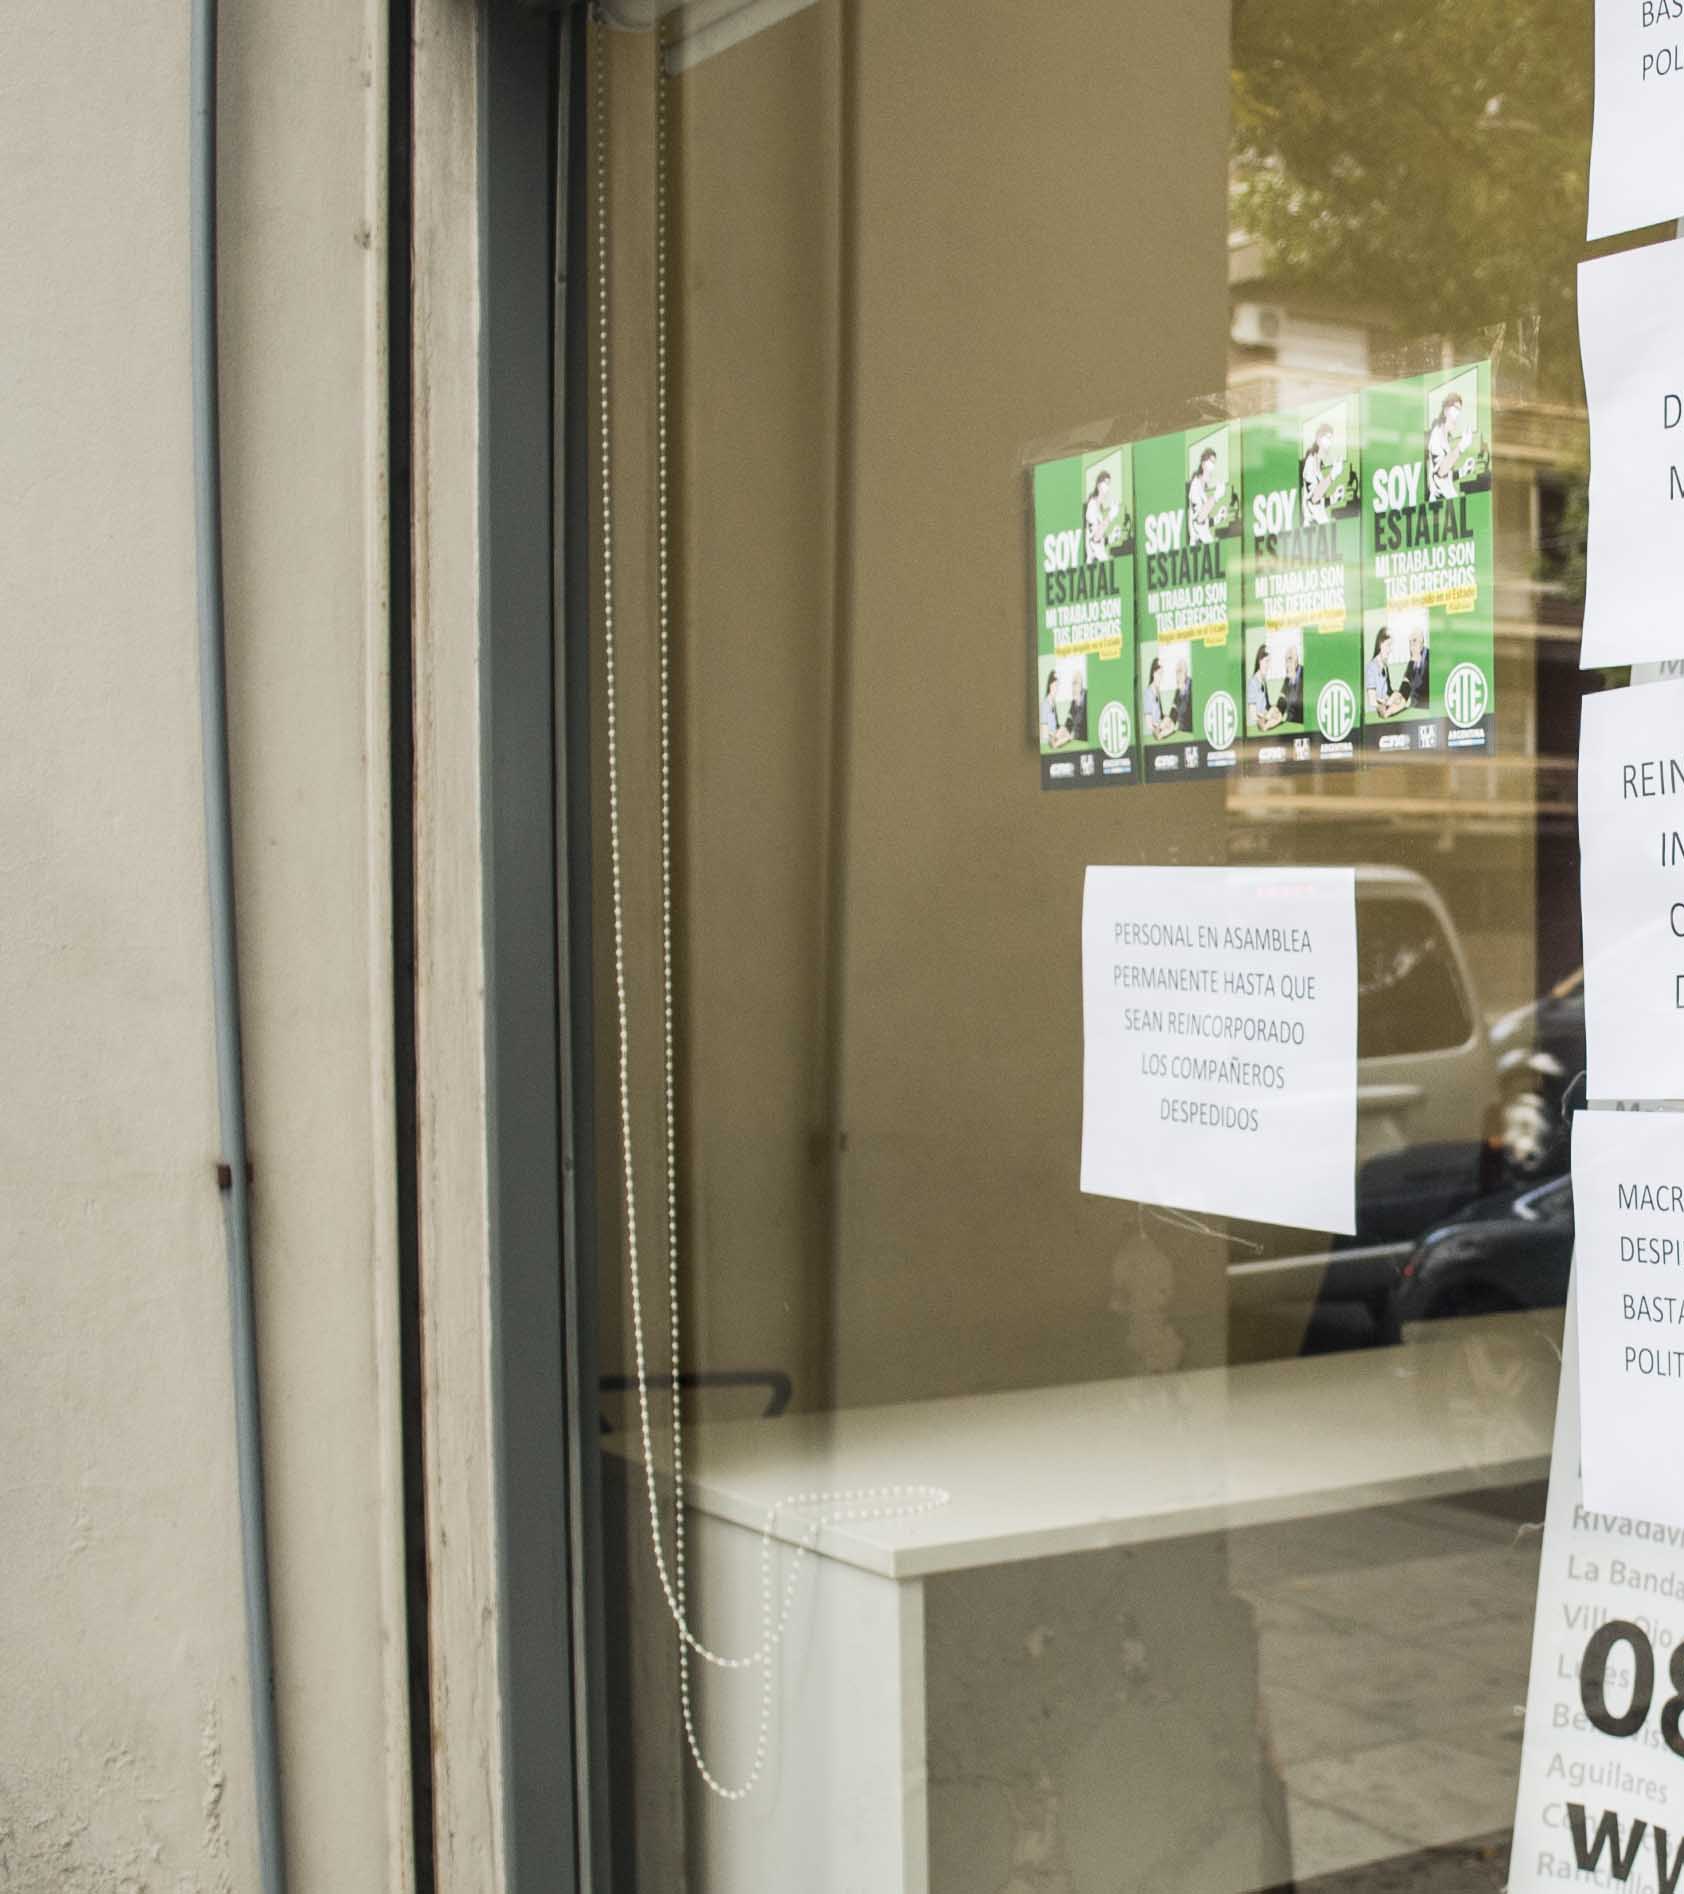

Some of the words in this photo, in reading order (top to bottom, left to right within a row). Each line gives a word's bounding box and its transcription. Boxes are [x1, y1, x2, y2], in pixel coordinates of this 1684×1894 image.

[1373, 462, 1422, 513] SOY
[1145, 510, 1184, 554] SOY
[1253, 488, 1296, 536] SOY
[1375, 496, 1473, 551] ESTATAL
[1044, 528, 1082, 572] SOY
[1147, 542, 1226, 590] ESTATAL
[1255, 522, 1343, 574] ESTATAL
[1392, 547, 1445, 575] TRABAJO
[1448, 542, 1475, 567] SON
[1046, 560, 1119, 606] ESTATAL
[1385, 576, 1408, 598] TUS
[1411, 566, 1475, 596] DERECHOS
[1115, 922, 1194, 948] PERSONAL
[1198, 925, 1218, 949] EN
[1223, 926, 1312, 953] ASAMBLEA
[1114, 965, 1219, 994] PERMANENTE
[1224, 971, 1276, 999] HASTA
[1281, 974, 1315, 1002] QUE
[1124, 1008, 1163, 1032] SEAN
[1168, 1011, 1304, 1045] REINCORPORADO
[1142, 1053, 1167, 1078] LOS
[1171, 1056, 1285, 1090] COMPAÑEROS
[1160, 1096, 1258, 1132] DESPEDIDOS
[1567, 1554, 1599, 1581] La
[1545, 1752, 1669, 1805] Aguilares
